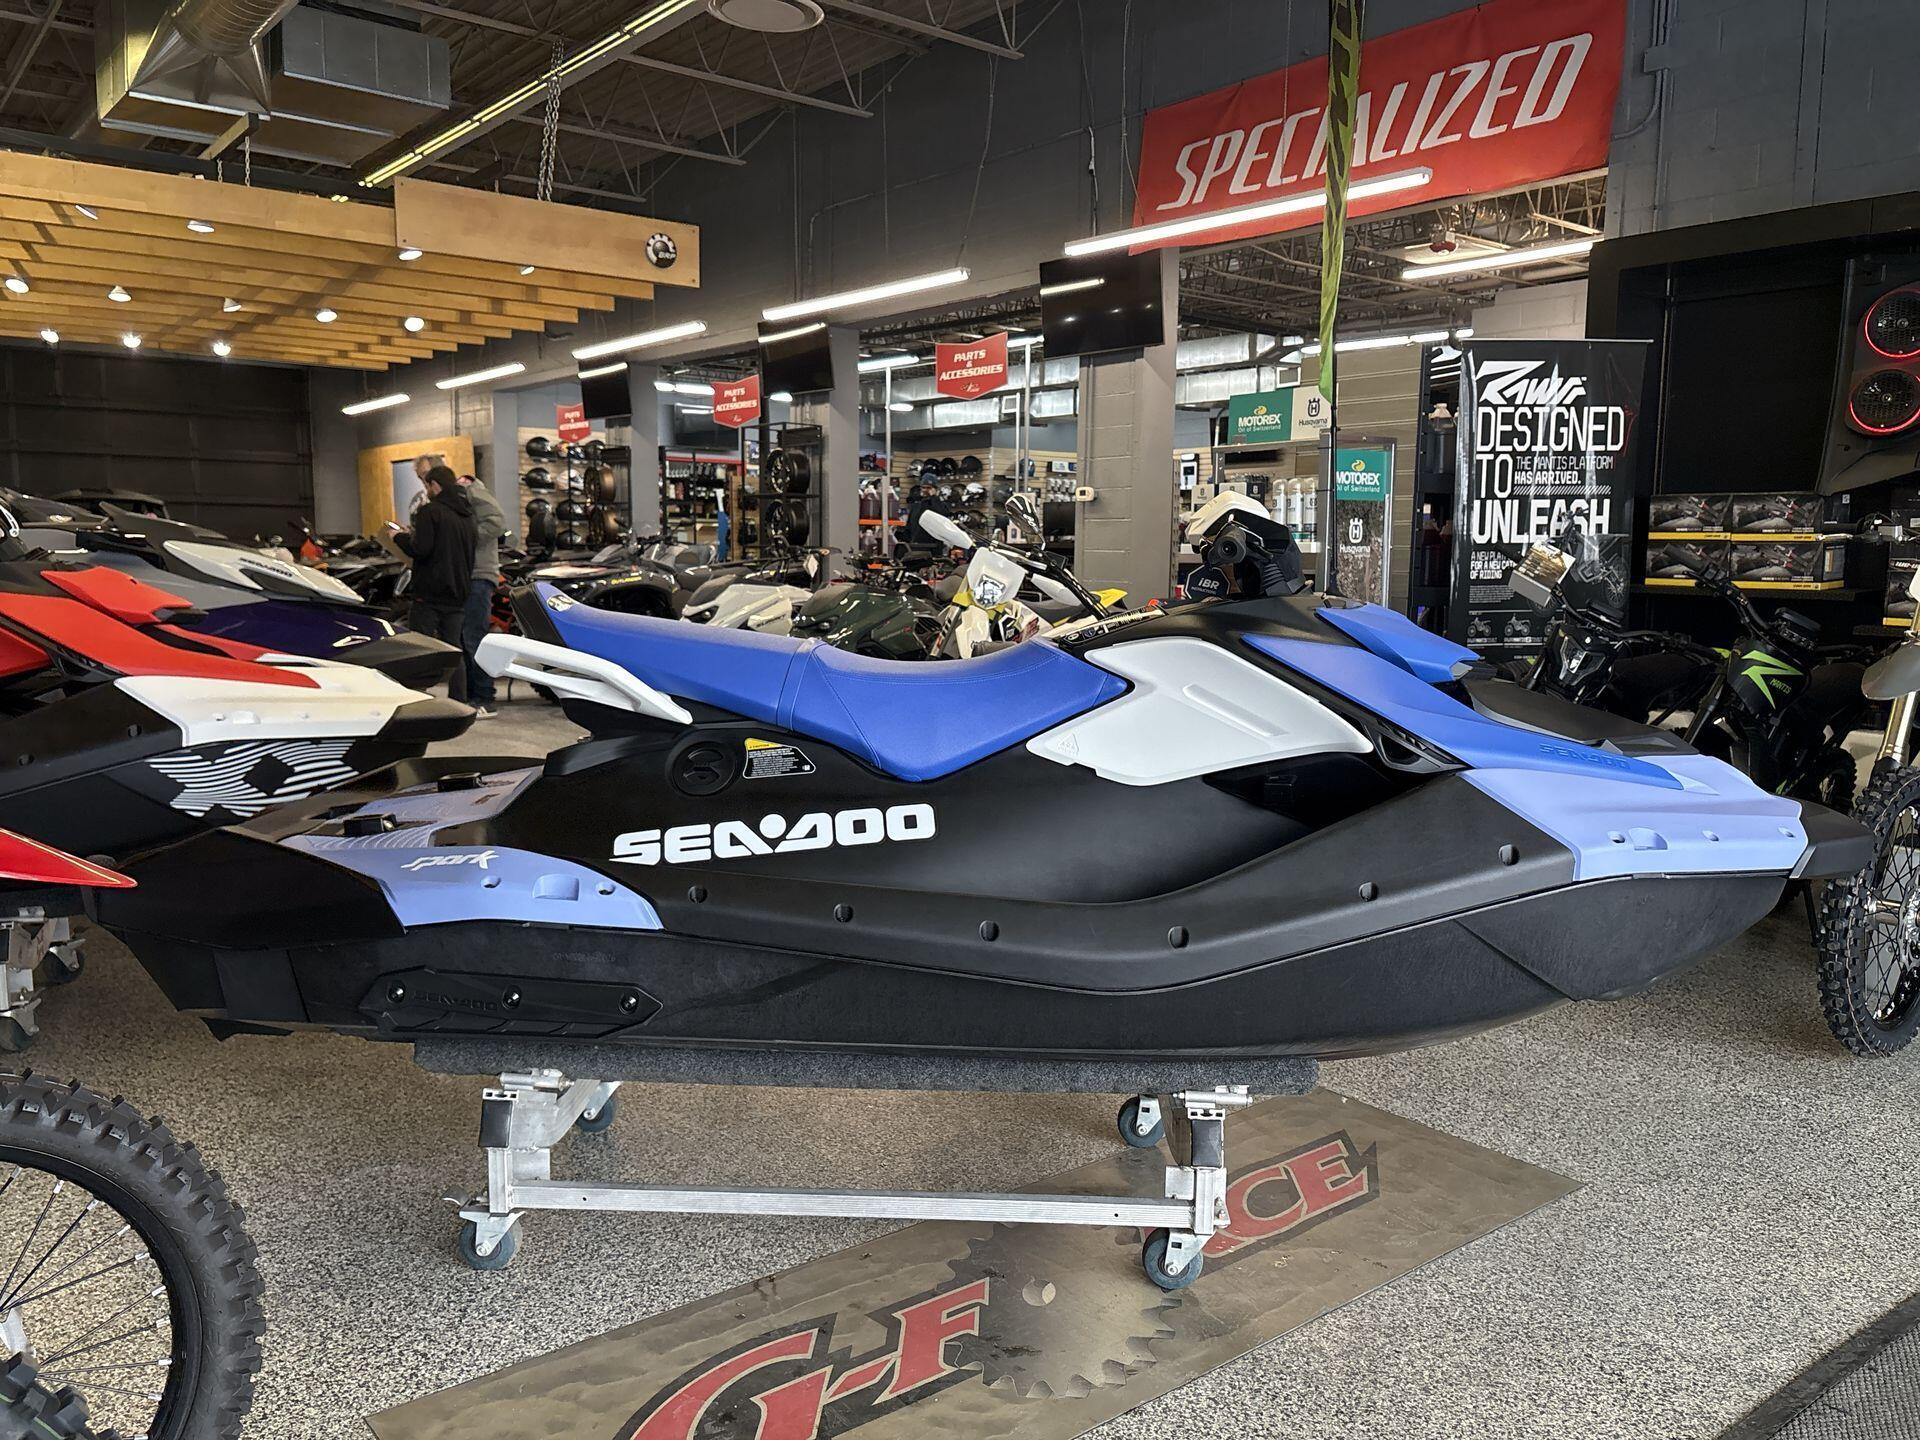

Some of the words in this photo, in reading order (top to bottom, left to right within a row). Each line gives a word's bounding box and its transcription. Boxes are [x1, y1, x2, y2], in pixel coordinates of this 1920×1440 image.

[1156, 32, 1593, 211] SPECIALIZED
[953, 349, 987, 363] PARTS
[966, 360, 973, 368] &
[939, 363, 1004, 381] ACCESSORIES
[724, 387, 746, 398] PARTS
[715, 400, 758, 412] ACCESSORIES
[1238, 414, 1281, 427] MOTOREX
[1298, 418, 1328, 427] Husqvarna
[1252, 424, 1282, 432] Switzerland
[1476, 406, 1625, 452] DESIGNED
[1516, 456, 1532, 470] THE
[1533, 456, 1567, 470] MANTIS
[1568, 456, 1614, 470] PLATFORM
[1336, 471, 1381, 486] MOTOREX
[1475, 453, 1514, 499] TO
[1514, 471, 1533, 485] HAS
[1535, 471, 1582, 485] ARRIVED.
[1350, 485, 1380, 493] Switzerland
[1472, 498, 1611, 545] UNLEASH
[1340, 545, 1371, 555] Husqvarna
[1476, 551, 1489, 561] NEW
[1470, 560, 1483, 570] FOR
[1489, 560, 1501, 570] NEW
[1470, 569, 1479, 580] OF
[1479, 569, 1503, 580] RIDING
[1198, 577, 1220, 590] iBR
[1769, 678, 1792, 695] MANTIS
